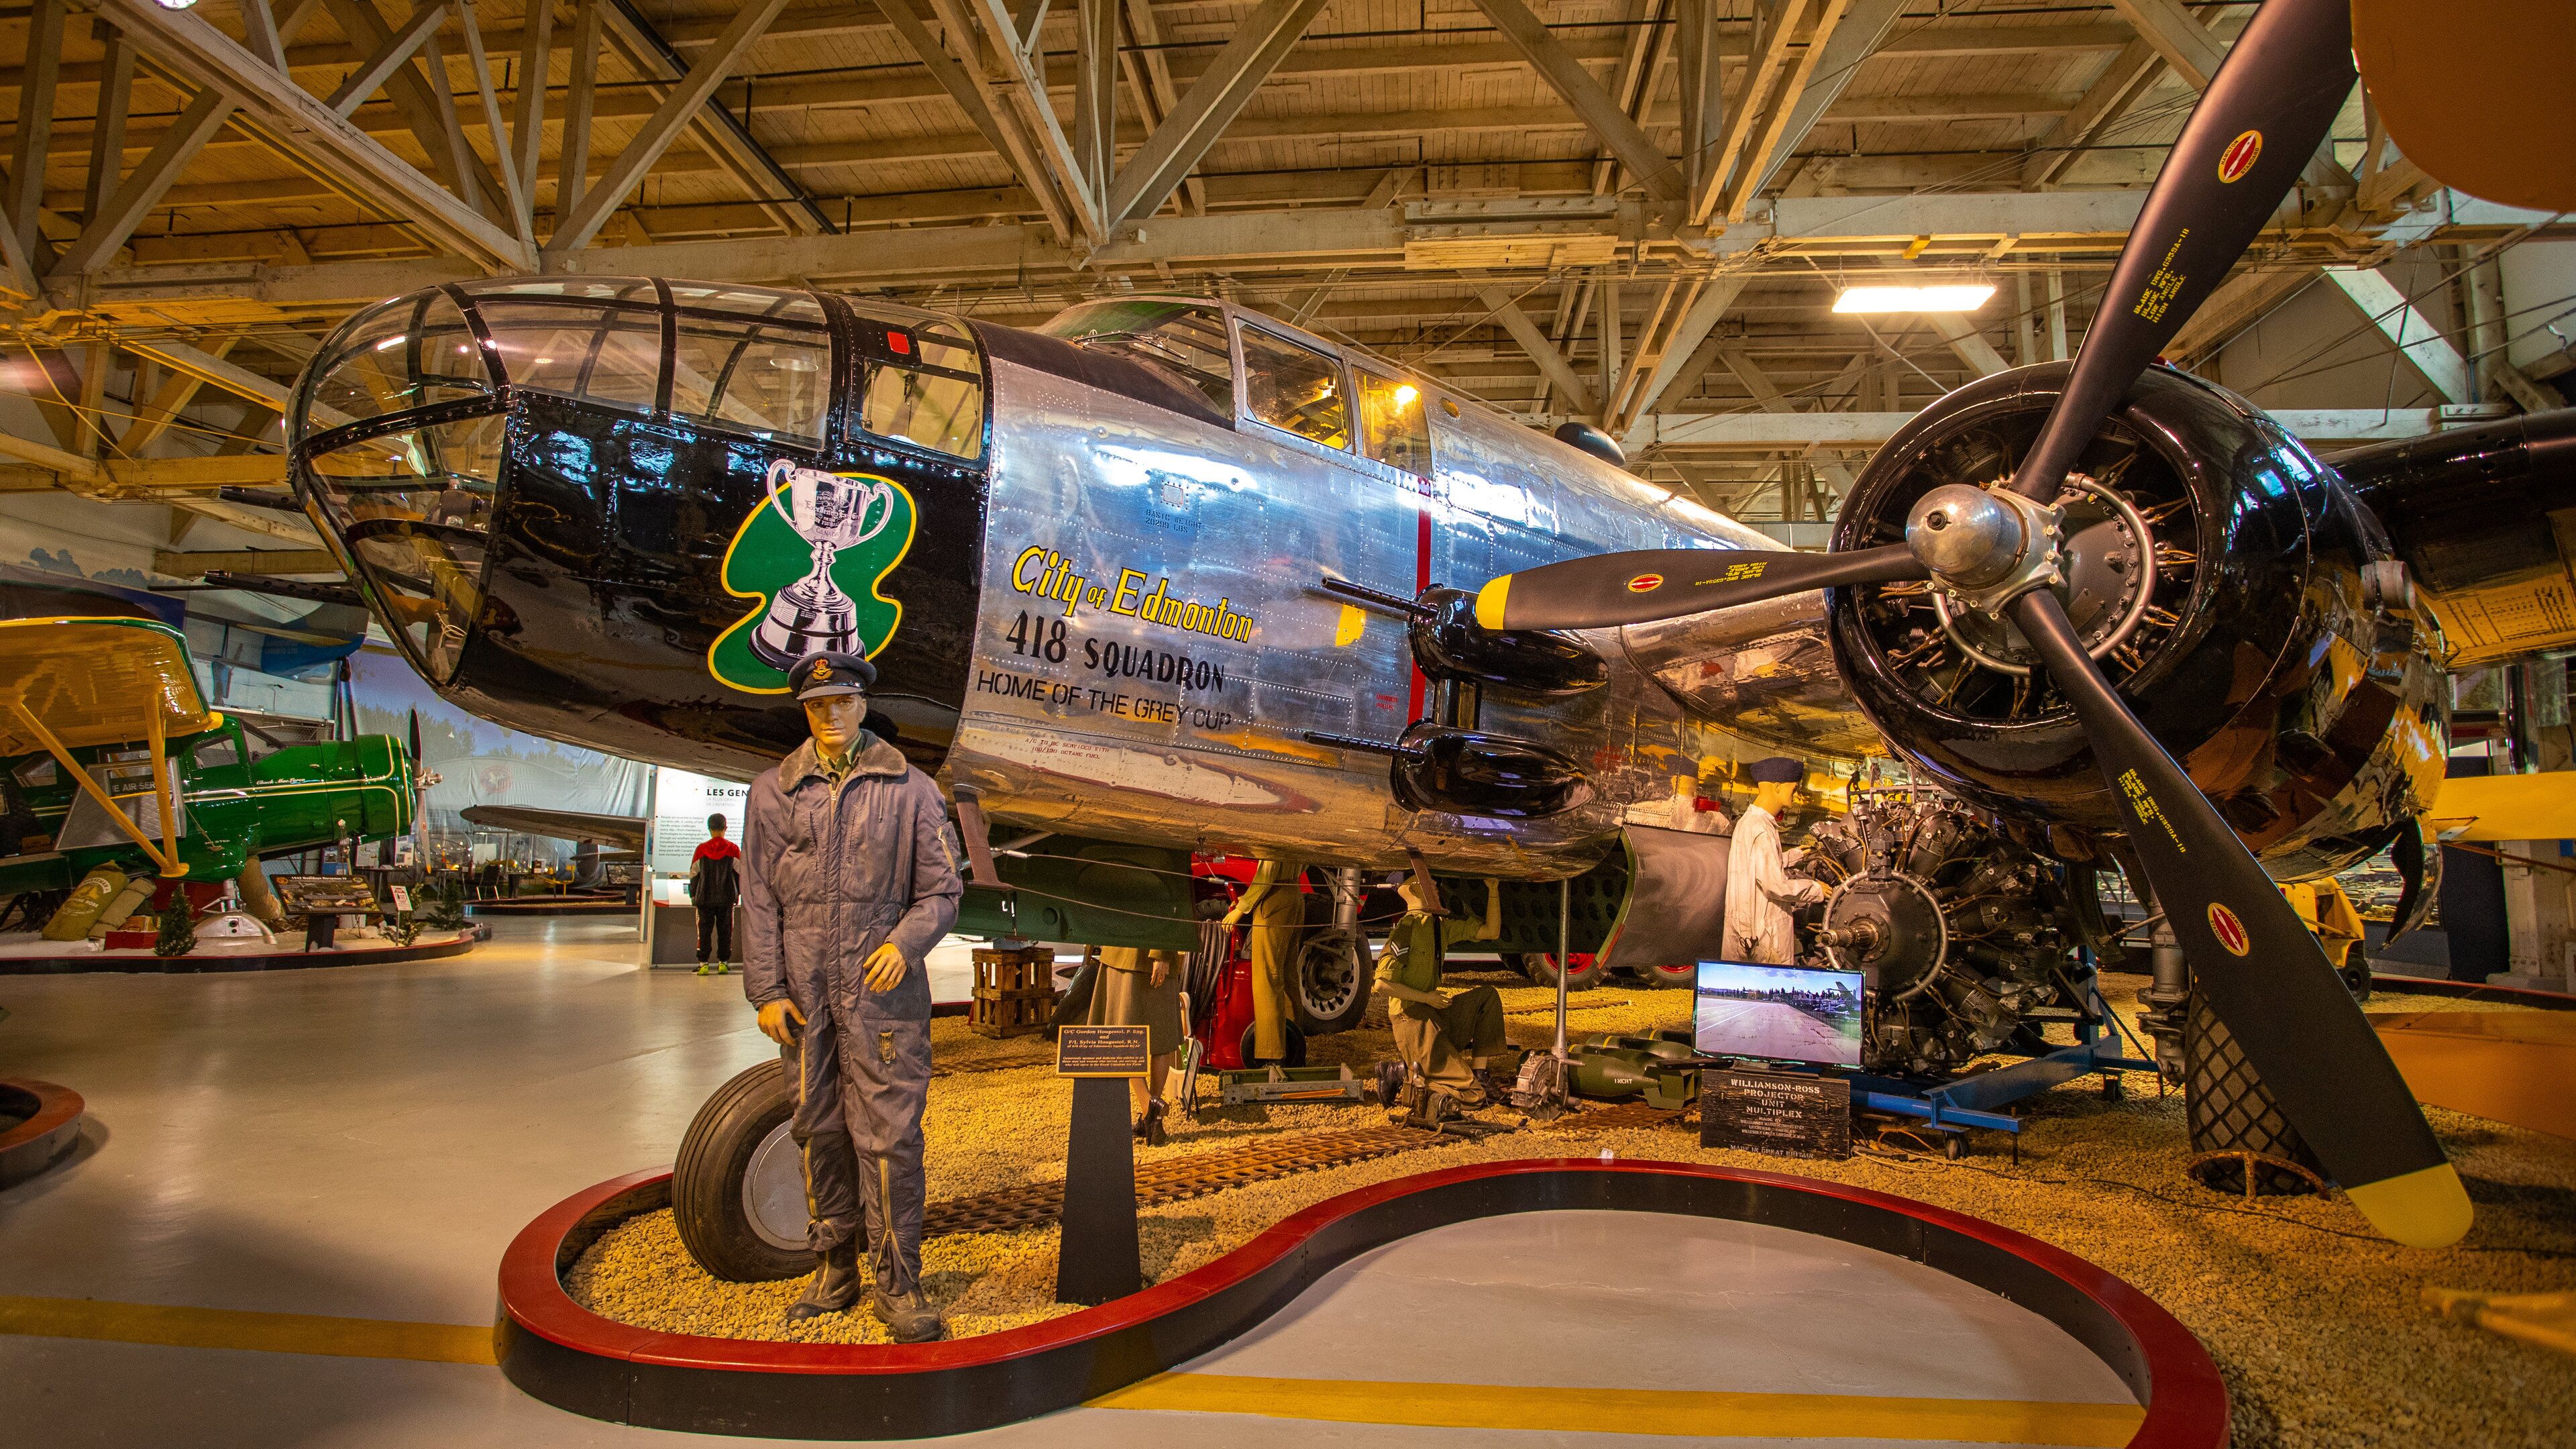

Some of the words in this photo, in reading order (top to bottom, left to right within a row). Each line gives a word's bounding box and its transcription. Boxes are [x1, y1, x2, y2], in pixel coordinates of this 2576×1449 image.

[2220, 140, 2239, 165] HAMILTON
[2241, 148, 2259, 173] STANDARD
[2133, 288, 2153, 314] BLADE
[2141, 291, 2159, 317] BLADE
[2147, 304, 2159, 319] LOW
[2159, 276, 2178, 301] ANGLE
[2152, 303, 2168, 323] HIGH
[2169, 274, 2186, 299] ANGLE
[1146, 509, 1170, 522] BASIC
[1174, 517, 1202, 529] WEIGHT
[1146, 517, 1169, 529] 20299
[1174, 524, 1188, 533] LBS
[1012, 545, 1085, 618] City
[1110, 566, 1254, 643] Edmonton
[1006, 610, 1067, 664] 418
[1084, 637, 1225, 693] SQUADRON
[977, 669, 1045, 702] HOME
[1051, 683, 1081, 706] OF
[1088, 690, 1130, 715] THE
[1134, 696, 1189, 726] GREY
[1192, 708, 1232, 731] CUP
[1063, 743, 1091, 751] SERVICED
[707, 788, 724, 796] LES
[2125, 772, 2143, 797] BLADE
[2129, 769, 2147, 793] BLADE
[2118, 777, 2131, 797] HIGH
[2132, 802, 2148, 825] ANGLE
[2122, 775, 2133, 790] LOW
[2133, 794, 2149, 818] ANGLE
[2210, 920, 2228, 947] STANDARD
[2229, 913, 2246, 938] HAMILTON
[1731, 1079, 1820, 1094] WILLIAMSON-ROSS
[1744, 1089, 1805, 1101] PROJECTOR
[1746, 1107, 1803, 1118] MULTIPLEX
[1762, 1099, 1784, 1108] UNIT
[1761, 1147, 1784, 1156] GREAT
[1786, 1150, 1813, 1159] BRITAIN
